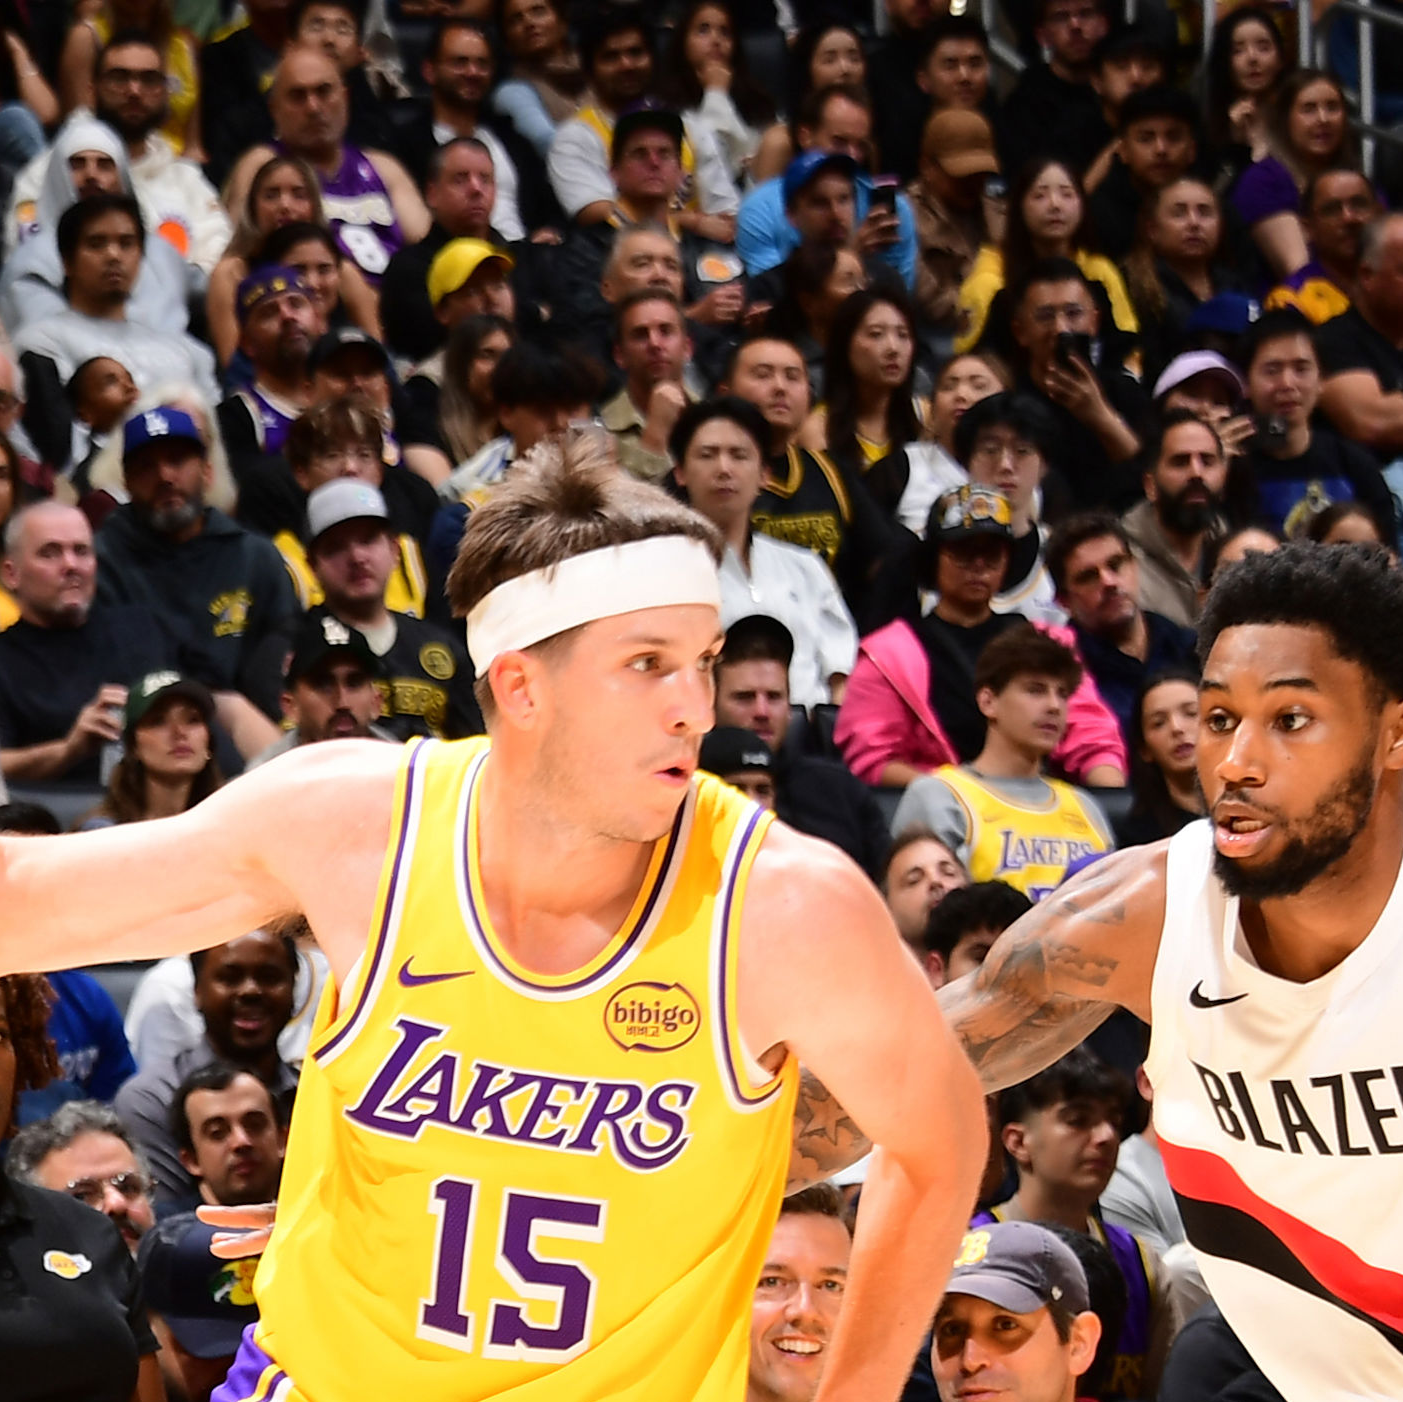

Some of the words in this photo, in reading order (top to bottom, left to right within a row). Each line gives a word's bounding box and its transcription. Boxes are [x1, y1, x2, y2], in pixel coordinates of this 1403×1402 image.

[339, 225, 391, 275] 8
[613, 1000, 695, 1032] bibigo
[345, 1016, 696, 1173] LAKERS
[416, 1176, 609, 1364] 15
